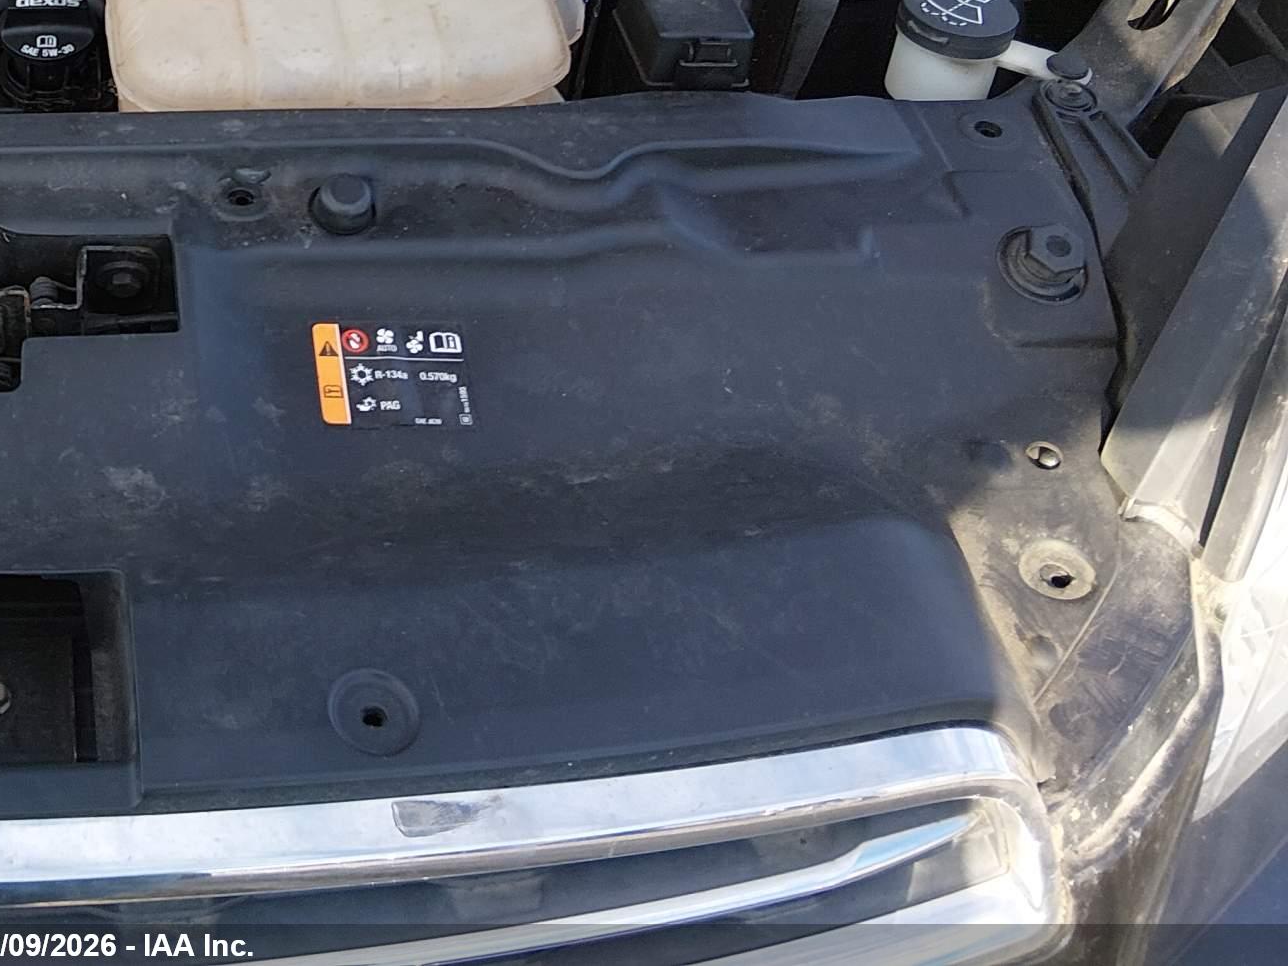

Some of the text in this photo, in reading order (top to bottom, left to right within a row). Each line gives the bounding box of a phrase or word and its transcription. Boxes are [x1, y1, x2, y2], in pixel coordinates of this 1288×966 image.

[20, 44, 40, 57] SAE
[376, 344, 398, 353] AUTO
[419, 372, 458, 383] 0.570kg
[380, 400, 401, 411] PAG
